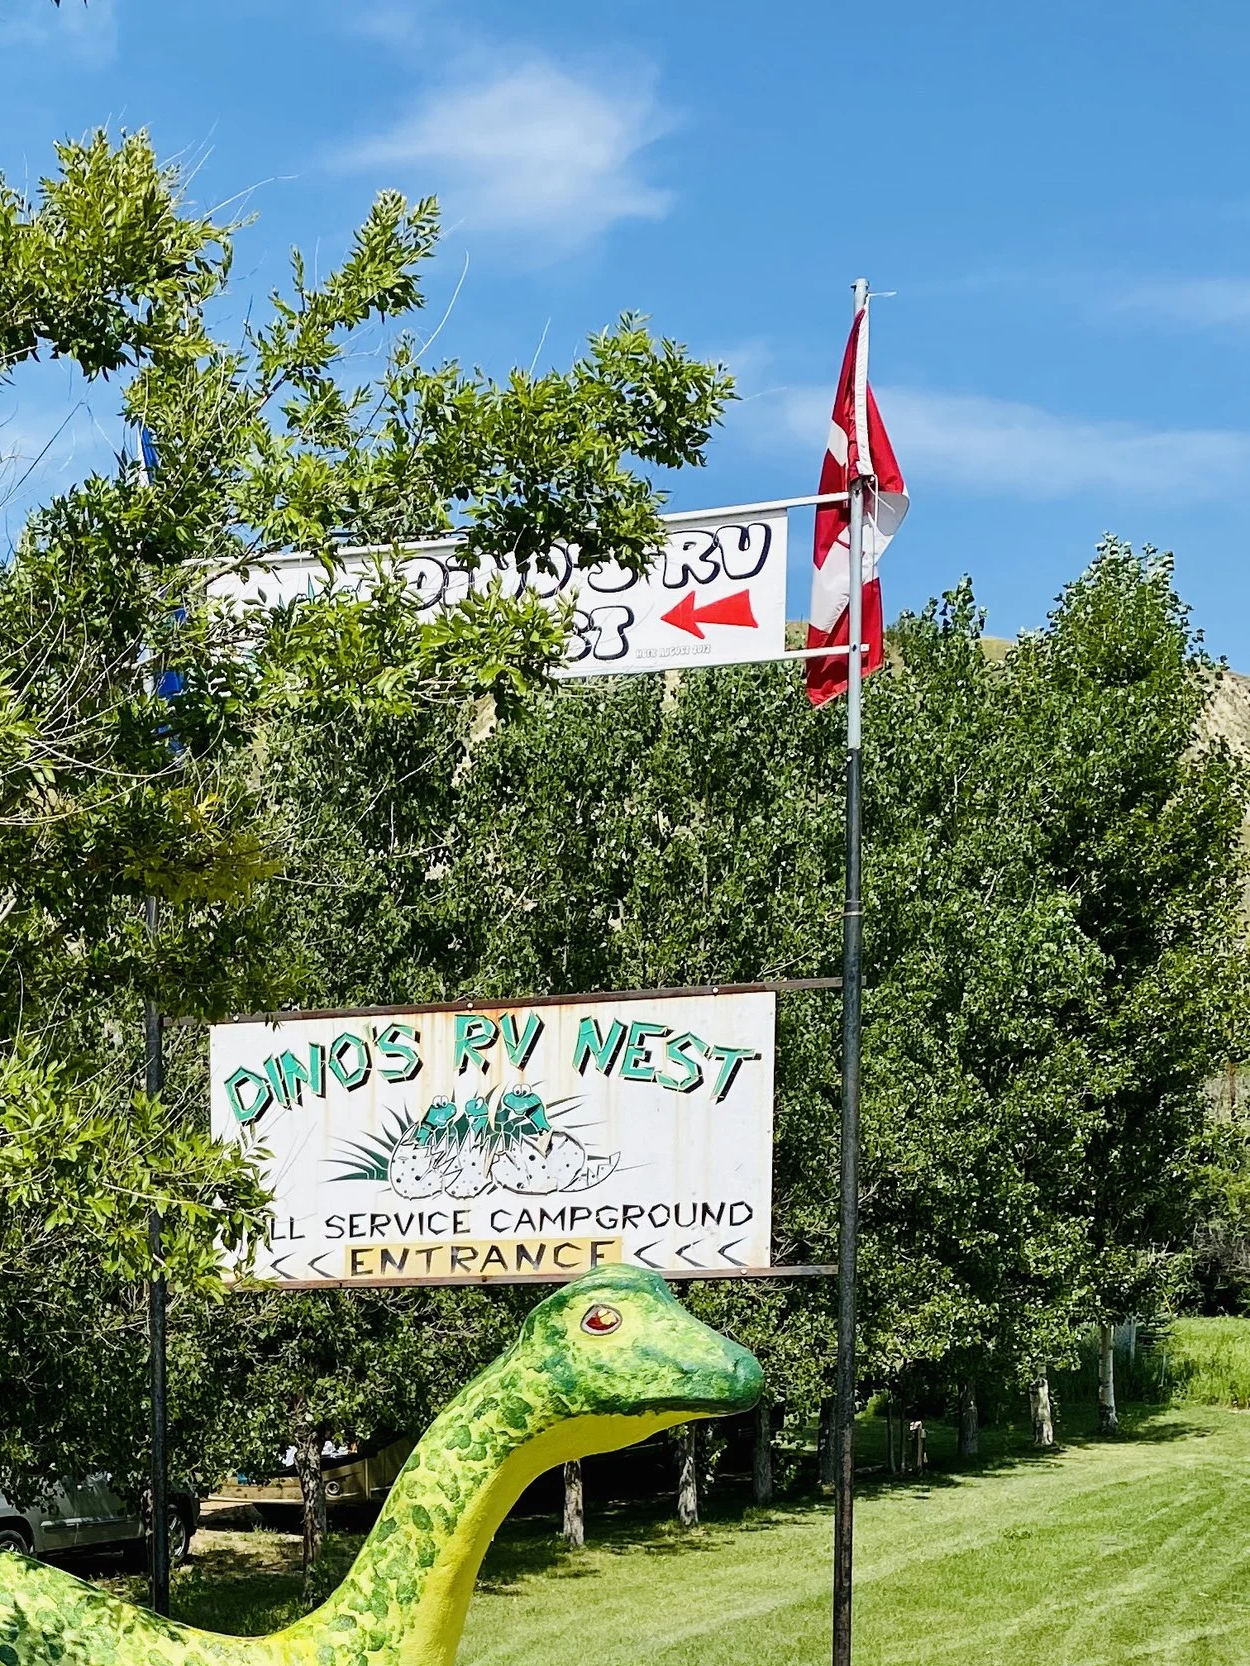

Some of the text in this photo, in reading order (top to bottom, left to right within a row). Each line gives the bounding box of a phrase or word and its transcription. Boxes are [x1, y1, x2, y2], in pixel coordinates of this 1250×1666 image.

[649, 522, 772, 589] RV
[224, 1010, 763, 1126] DINO'S RV NEST
[270, 1200, 754, 1241] LL SERVICE CAMPGROUND
[350, 1240, 617, 1276] ENTRANCE
